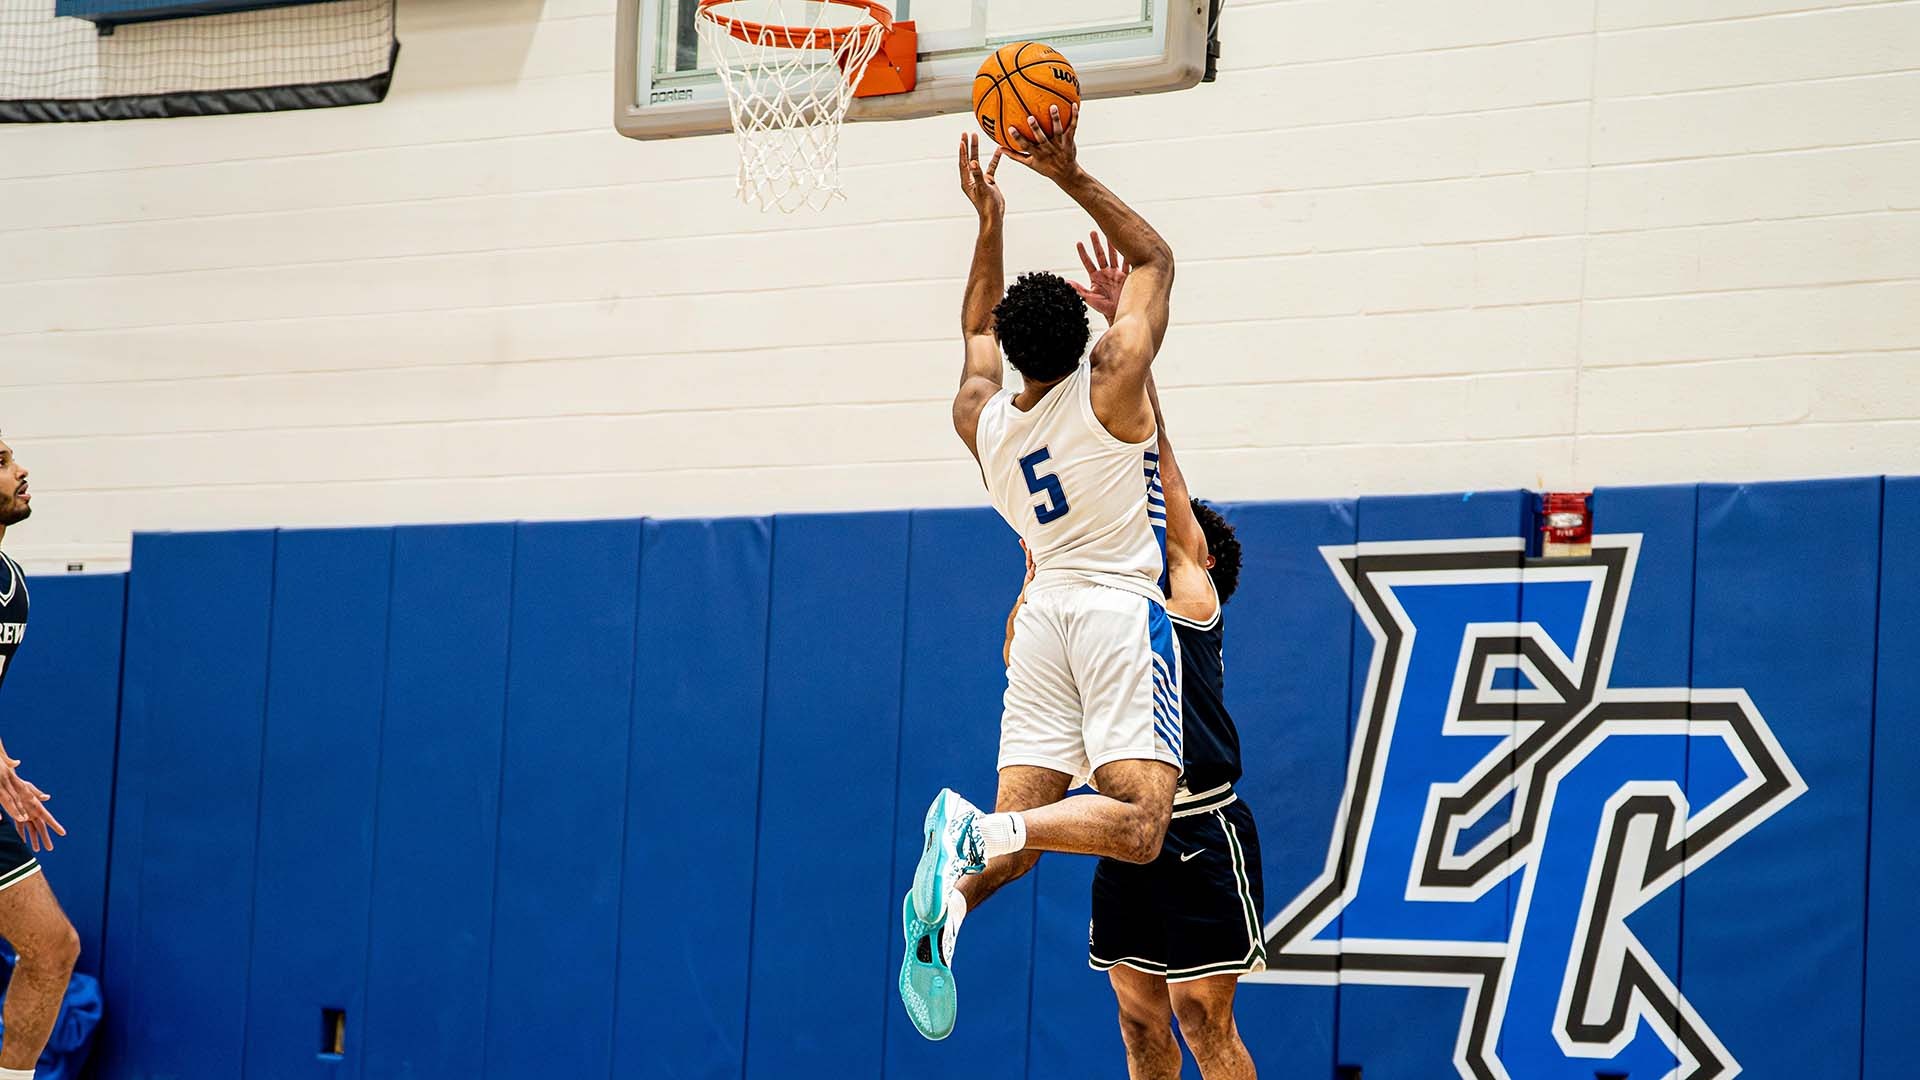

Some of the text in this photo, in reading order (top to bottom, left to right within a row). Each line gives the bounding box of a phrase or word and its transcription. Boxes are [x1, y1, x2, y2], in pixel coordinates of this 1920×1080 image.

[650, 88, 693, 104] porter
[1018, 446, 1070, 525] 5
[1237, 533, 1808, 1080] EC
